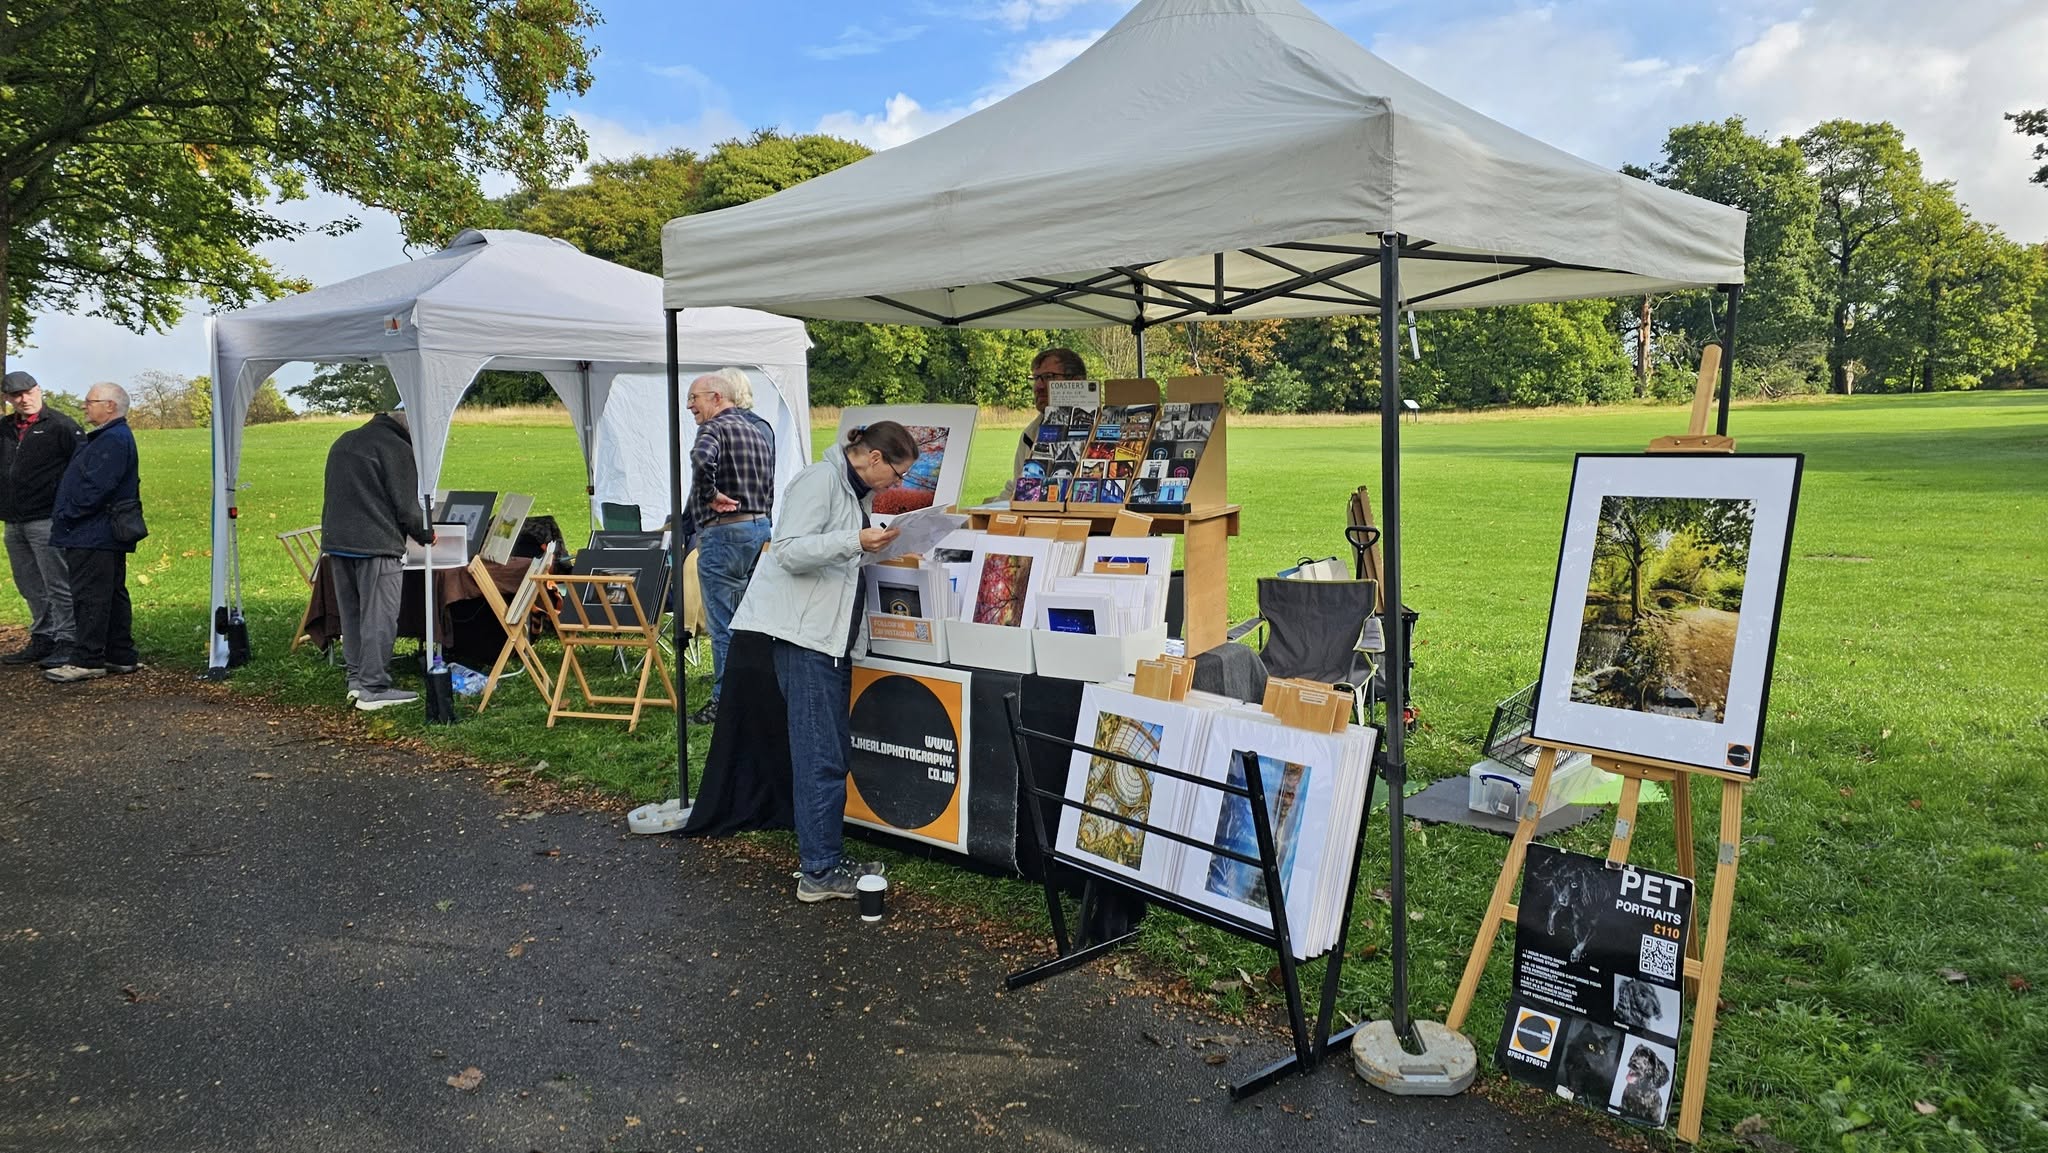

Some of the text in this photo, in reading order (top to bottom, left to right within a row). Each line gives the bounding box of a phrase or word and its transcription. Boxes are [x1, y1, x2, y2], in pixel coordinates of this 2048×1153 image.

[925, 735, 955, 752] WWW.
[928, 767, 955, 784] CO.UK
[1620, 869, 1685, 908] PET
[1616, 899, 1681, 925] PORTRAITS
[1654, 924, 1680, 939] £110
[1532, 967, 1558, 979] PERSONALITY
[1565, 1003, 1587, 1014] AVAILABLE
